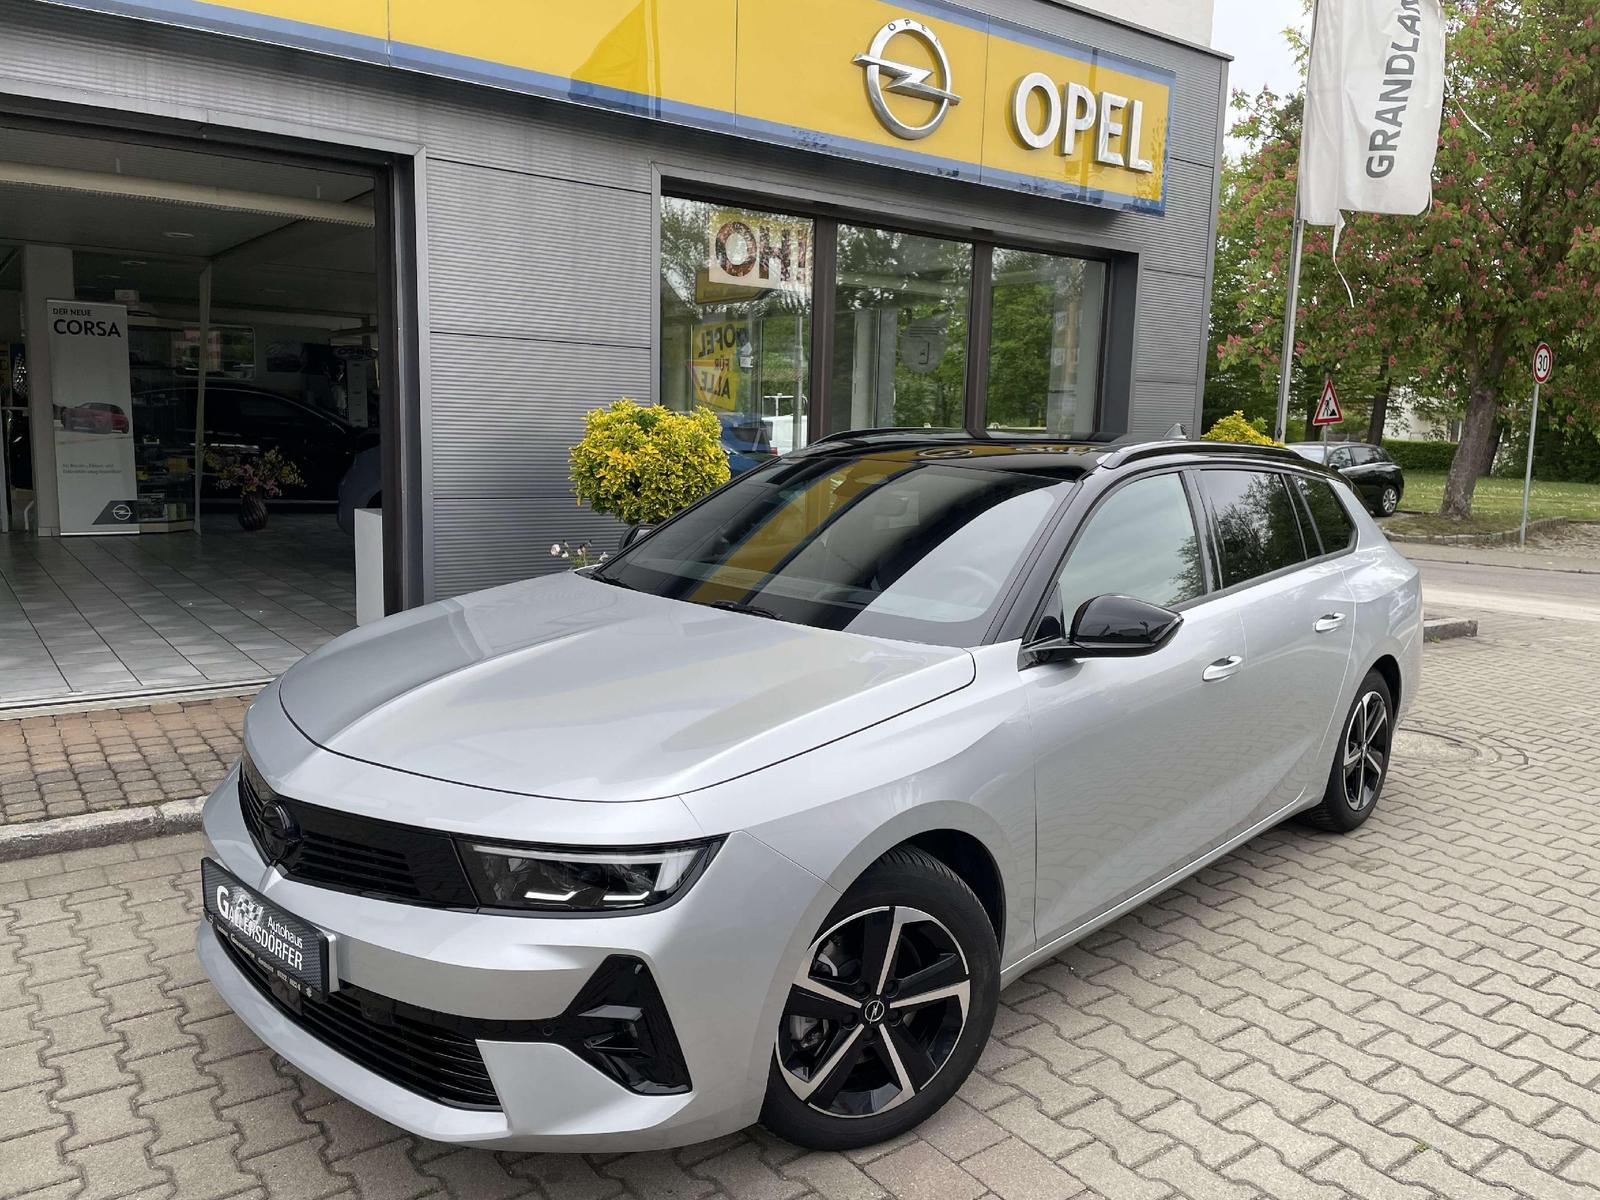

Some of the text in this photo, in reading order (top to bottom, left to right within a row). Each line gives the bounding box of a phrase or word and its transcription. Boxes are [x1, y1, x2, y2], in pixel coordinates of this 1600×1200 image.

[887, 18, 940, 47] OPEL
[1011, 72, 1153, 173] OPEL
[53, 319, 121, 338] CORSA
[1537, 354, 1548, 372] 30
[267, 915, 303, 949] Autohaus
